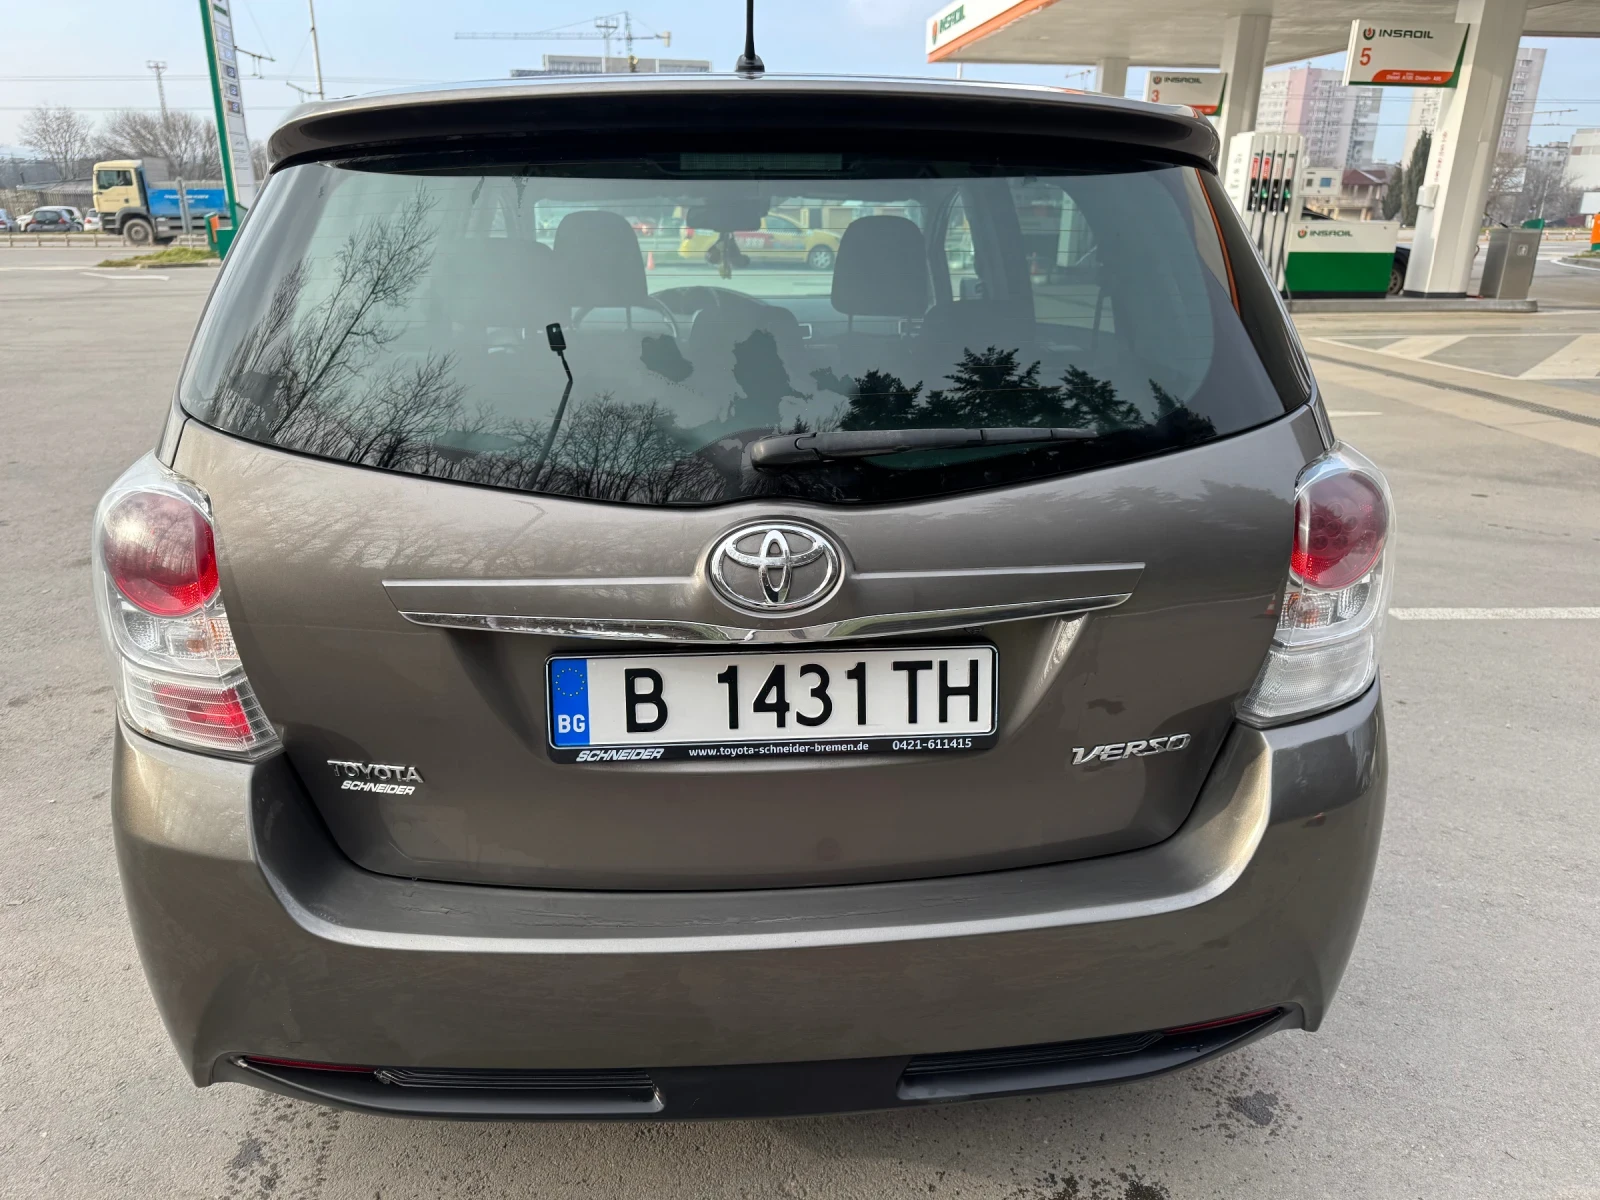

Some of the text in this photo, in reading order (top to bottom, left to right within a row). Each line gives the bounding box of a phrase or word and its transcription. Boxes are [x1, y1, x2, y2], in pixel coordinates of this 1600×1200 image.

[1378, 29, 1434, 39] INSAOIL
[1359, 47, 1372, 66] 5
[1164, 76, 1202, 84] INSAOIL
[1151, 89, 1160, 103] 3
[624, 659, 980, 733] B 1431 TH
[557, 714, 586, 734] BG
[688, 742, 869, 757] www.toyota-schneider-bremen.de
[892, 739, 972, 750] 0421-611415
[1072, 733, 1191, 765] VERSO
[576, 748, 665, 762] SCHNEIDER
[327, 760, 424, 783] TOYOTA
[341, 780, 416, 795] SCHNEIDER
